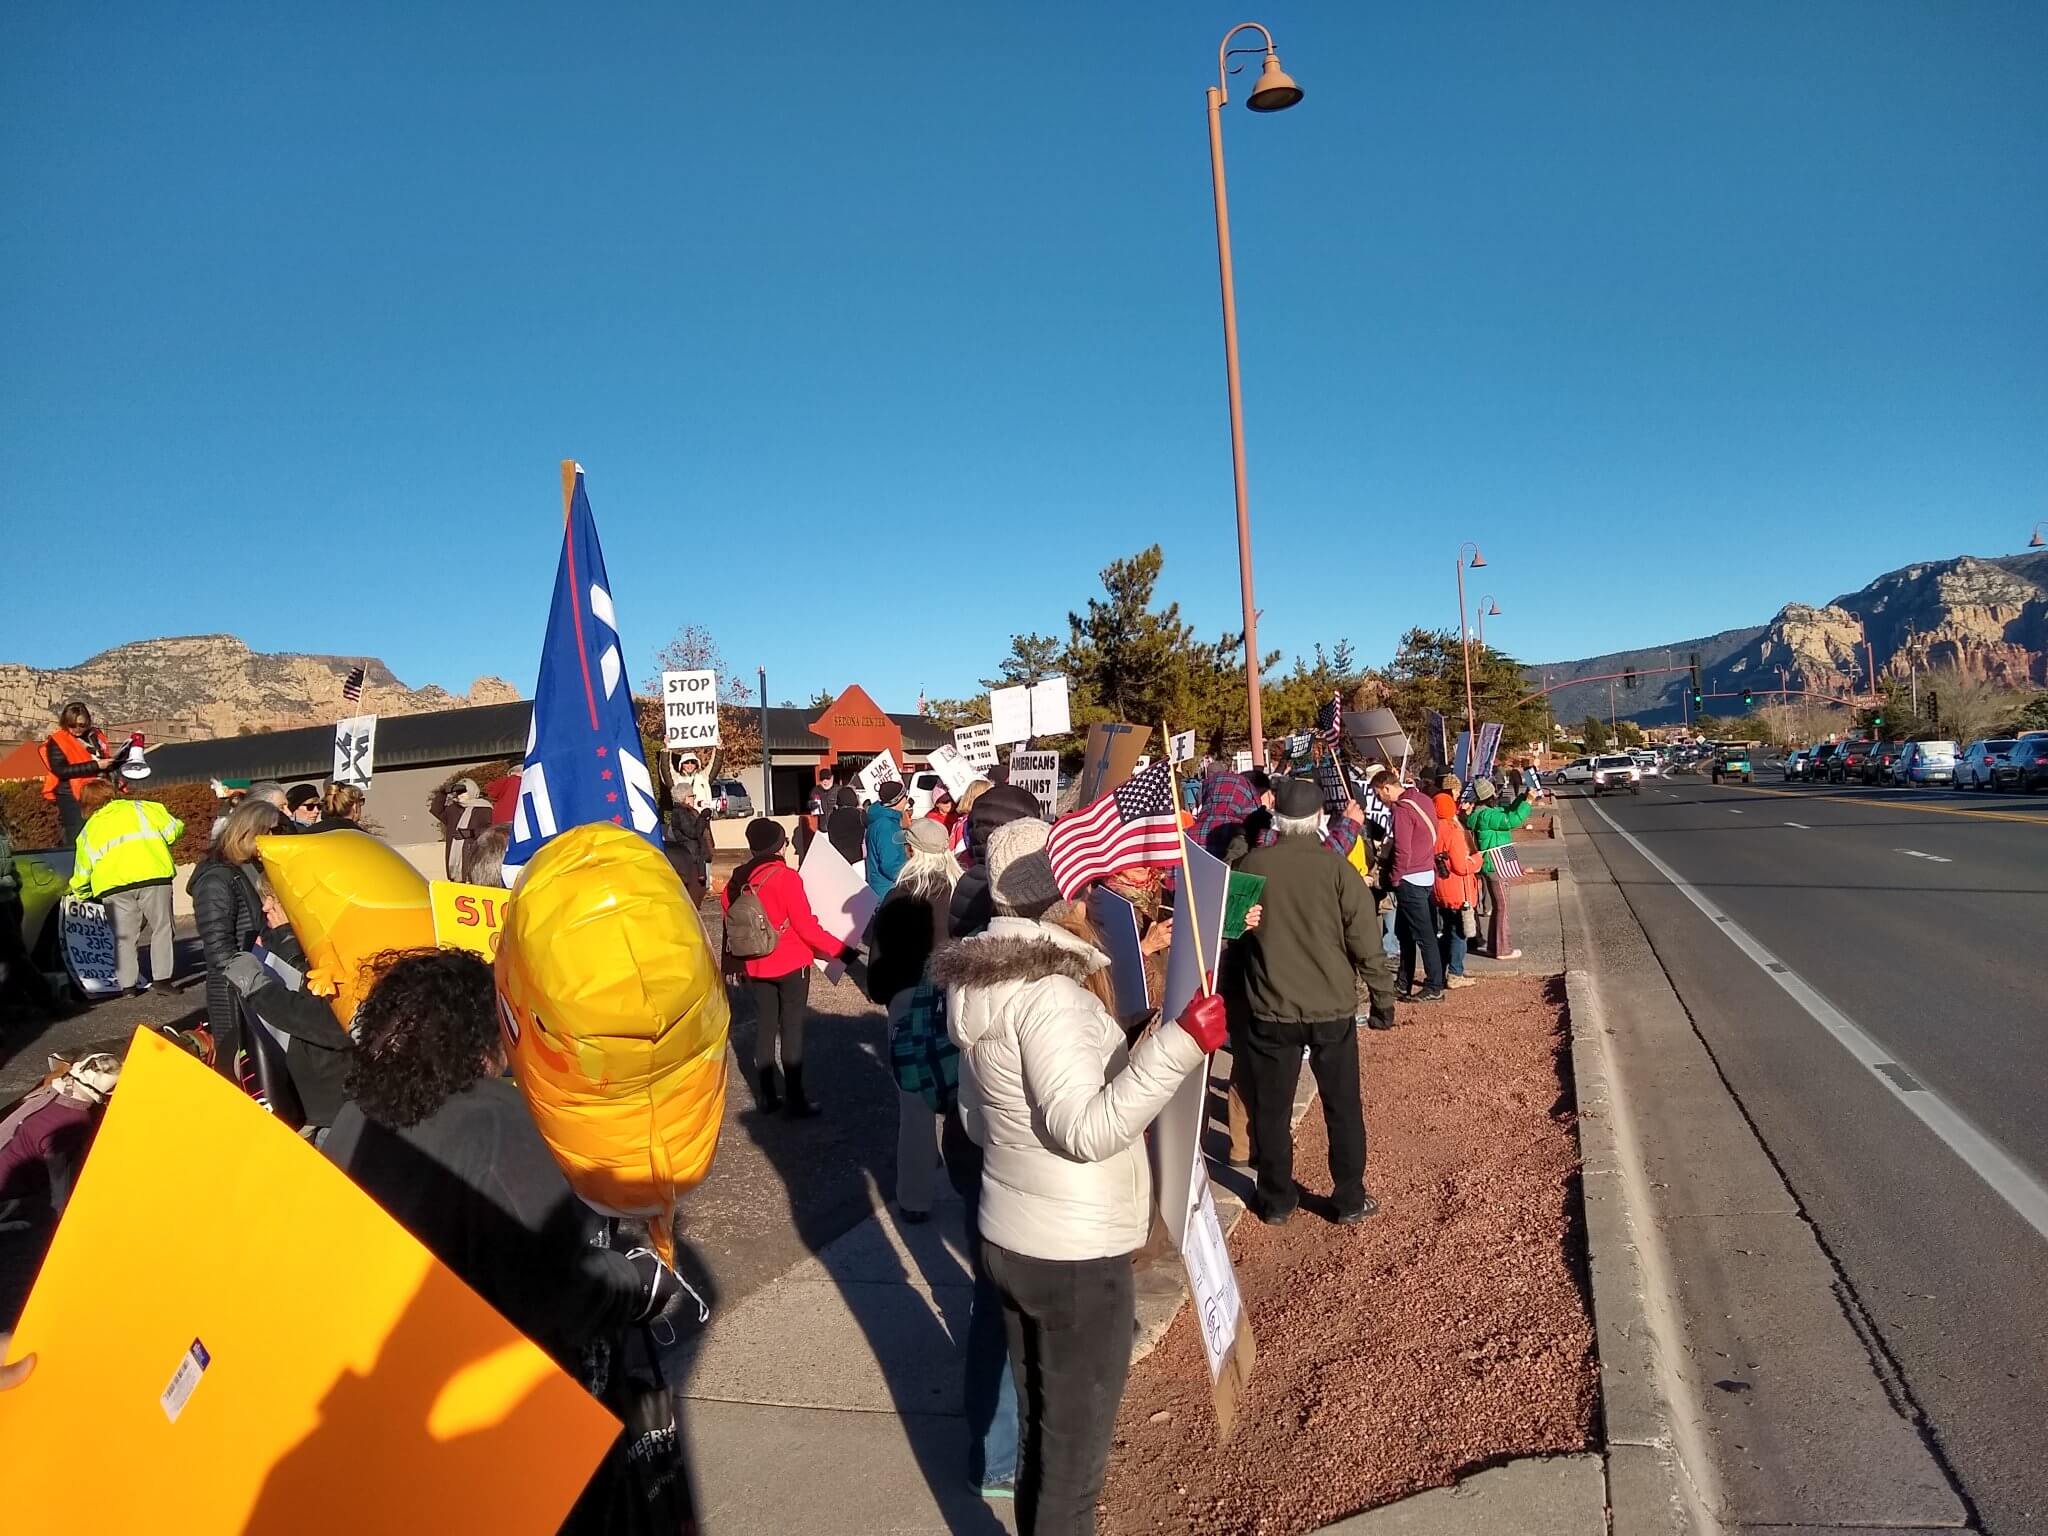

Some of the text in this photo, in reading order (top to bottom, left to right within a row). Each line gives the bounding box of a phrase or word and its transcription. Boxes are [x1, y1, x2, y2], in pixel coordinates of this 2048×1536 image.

[669, 678, 710, 693] STOP
[667, 700, 715, 717] TRUTH
[669, 725, 716, 740] DECAY
[870, 759, 890, 778] LIAR
[1011, 756, 1055, 771] AMERICANS
[1015, 780, 1051, 793] AGAINST
[71, 946, 114, 967] BIGGS
